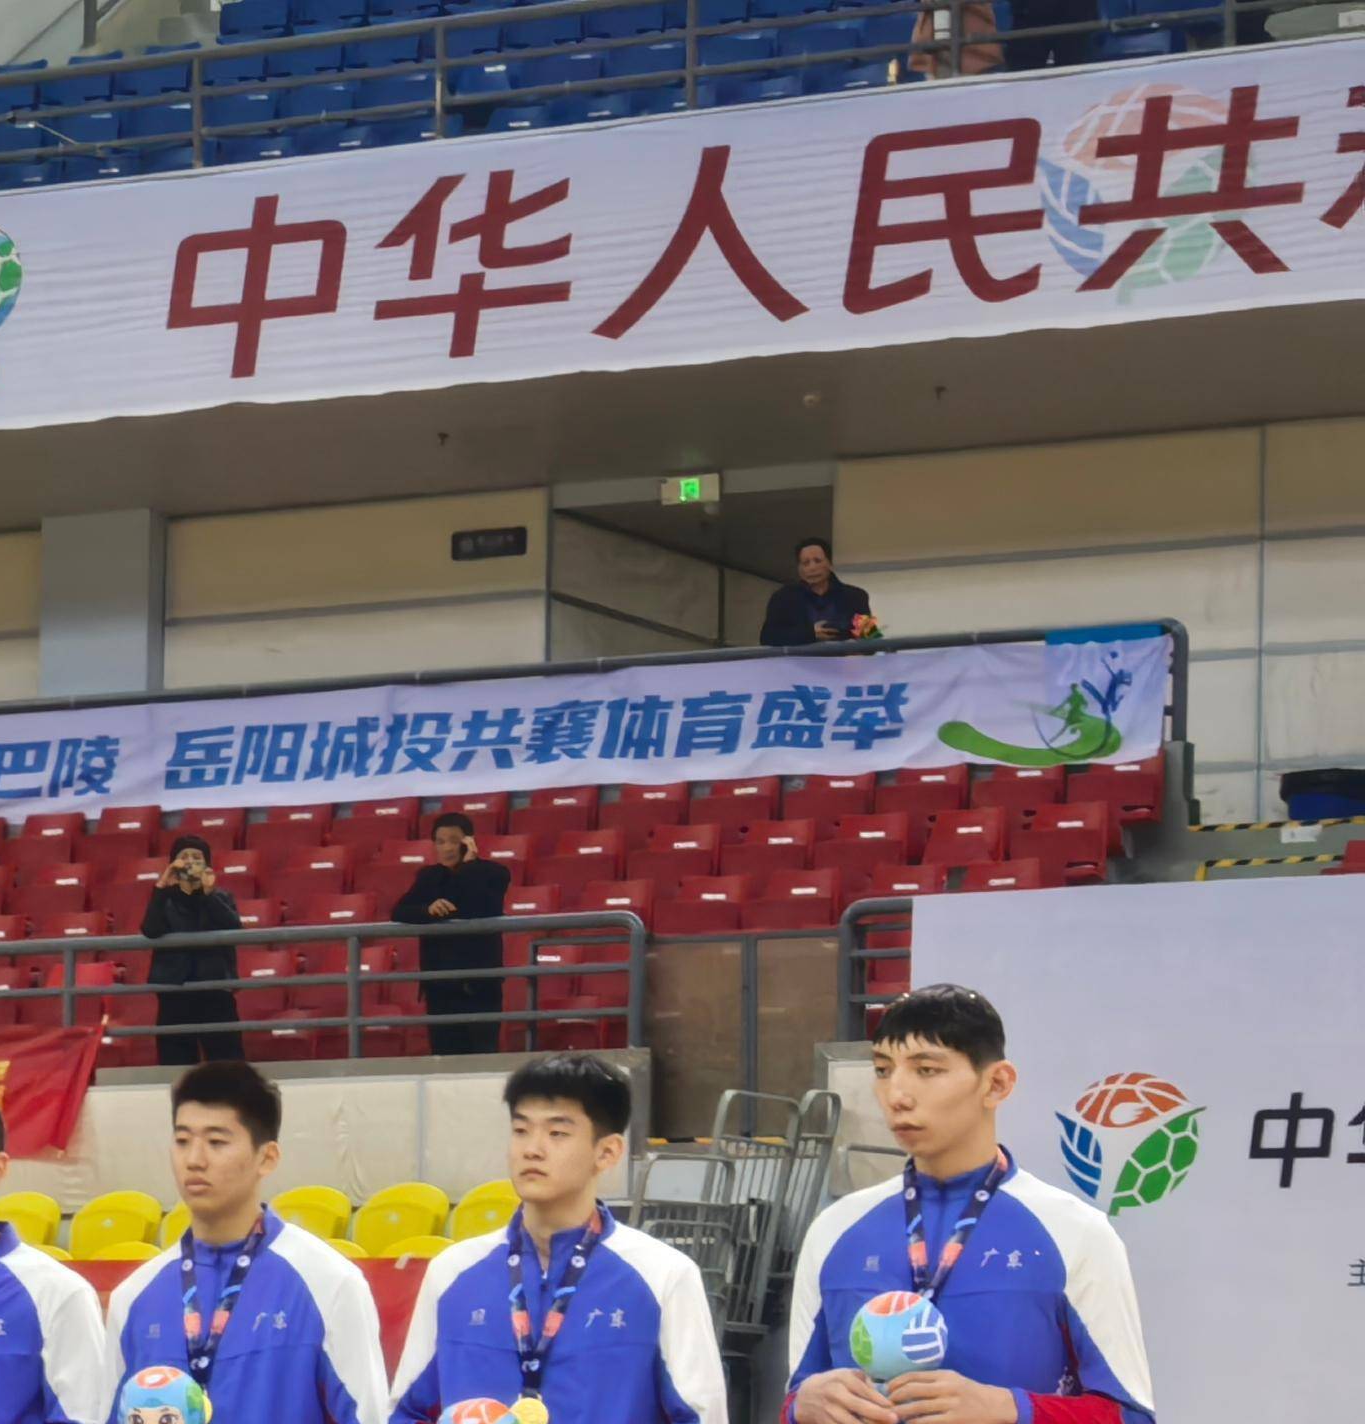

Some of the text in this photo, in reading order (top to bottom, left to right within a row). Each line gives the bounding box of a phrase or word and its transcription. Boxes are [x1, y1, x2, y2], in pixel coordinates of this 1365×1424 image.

[164, 683, 909, 790] 岳阳城投共襄体育盛举
